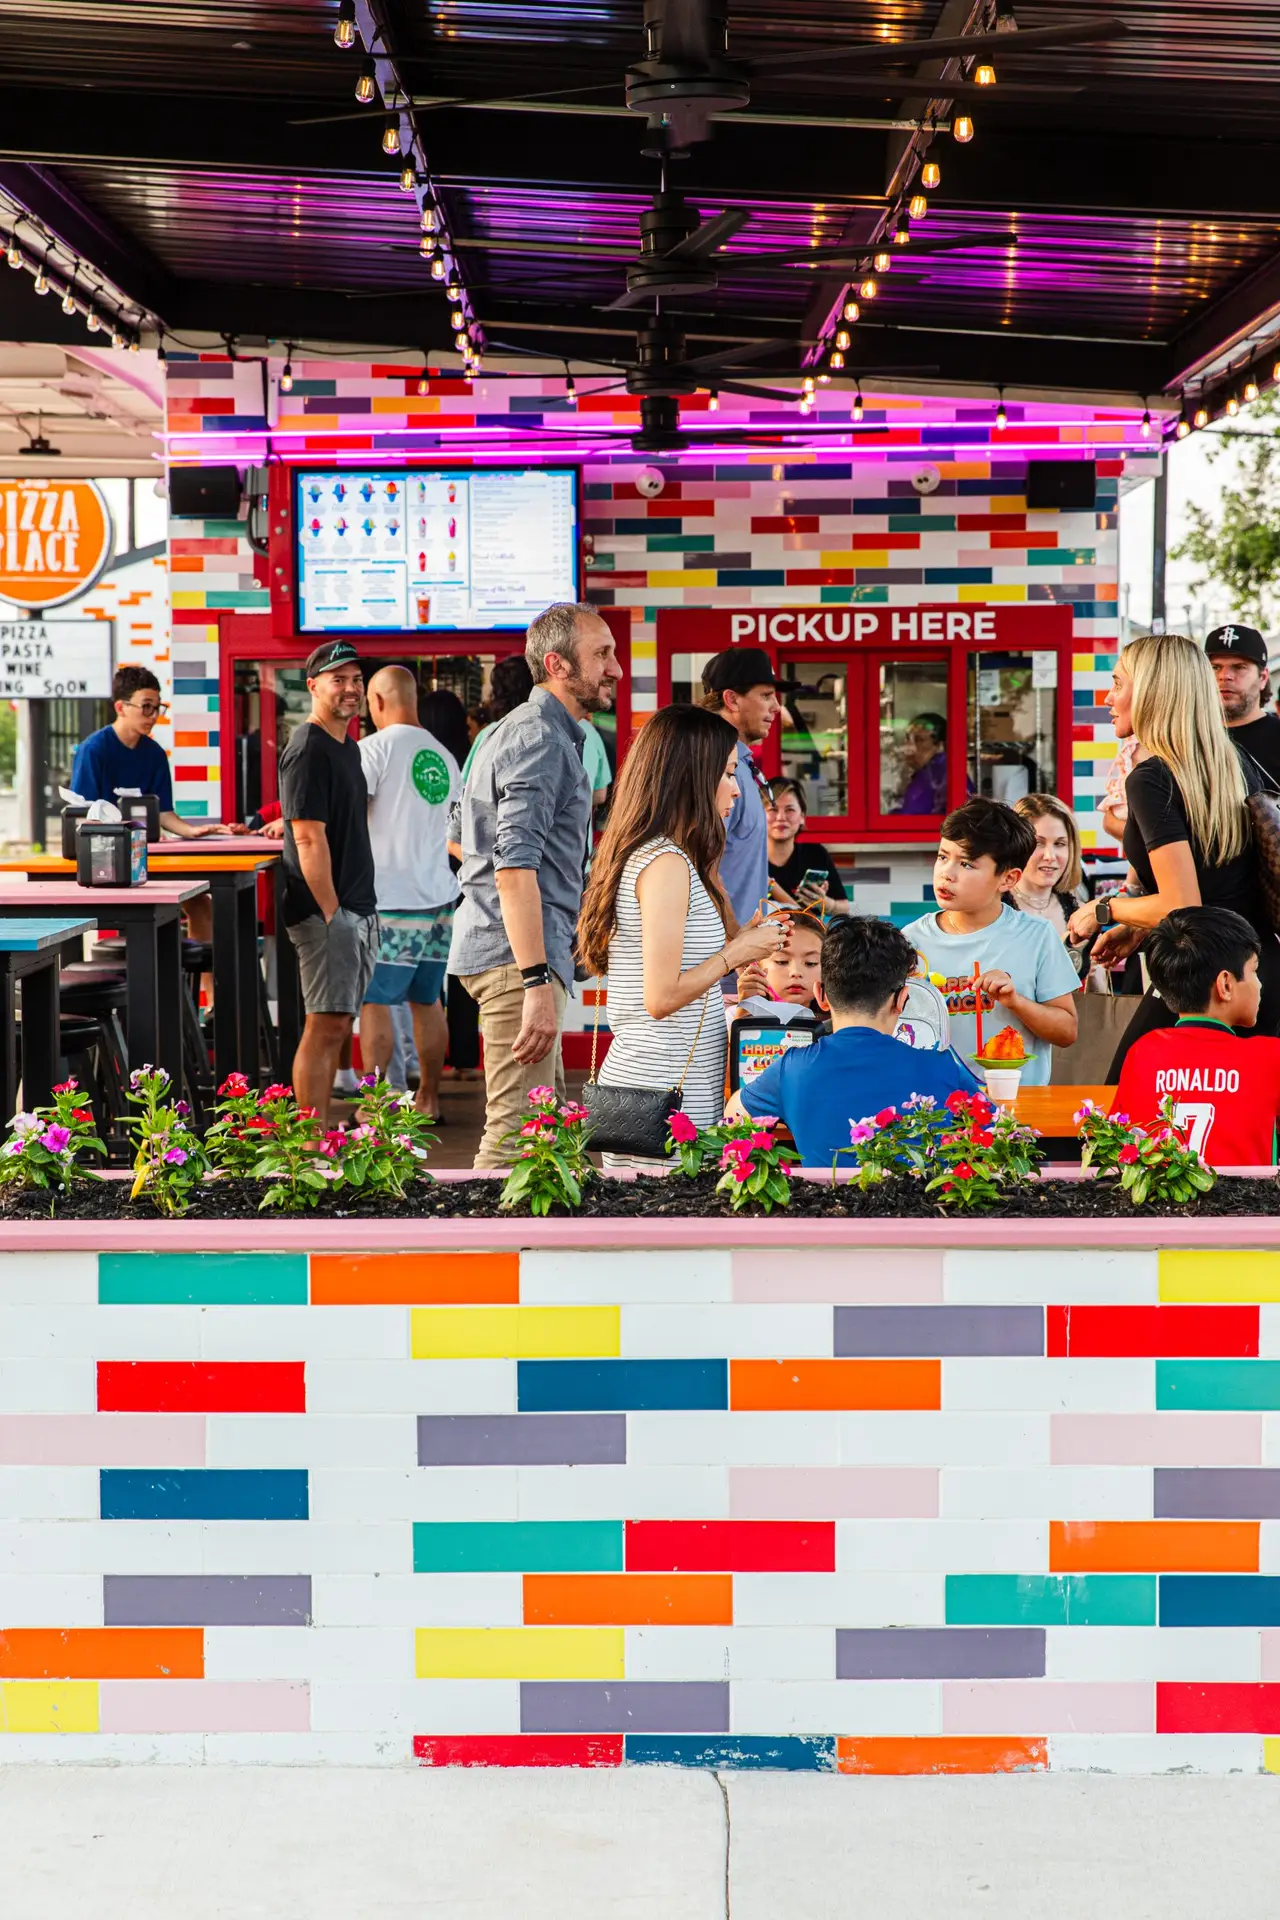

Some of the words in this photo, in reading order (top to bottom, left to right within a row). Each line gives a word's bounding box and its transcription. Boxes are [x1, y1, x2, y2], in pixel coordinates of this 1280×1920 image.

[0, 490, 80, 531] IZZA
[0, 530, 80, 572] LACE
[1, 626, 47, 639] PIZZA
[731, 612, 879, 643] PICKUP
[891, 611, 997, 641] HERE
[3, 644, 53, 658] PASTA
[7, 662, 42, 676] WINE
[44, 680, 87, 698] SOON
[1155, 1068, 1240, 1093] RONALDO
[1172, 1103, 1215, 1160] 7
